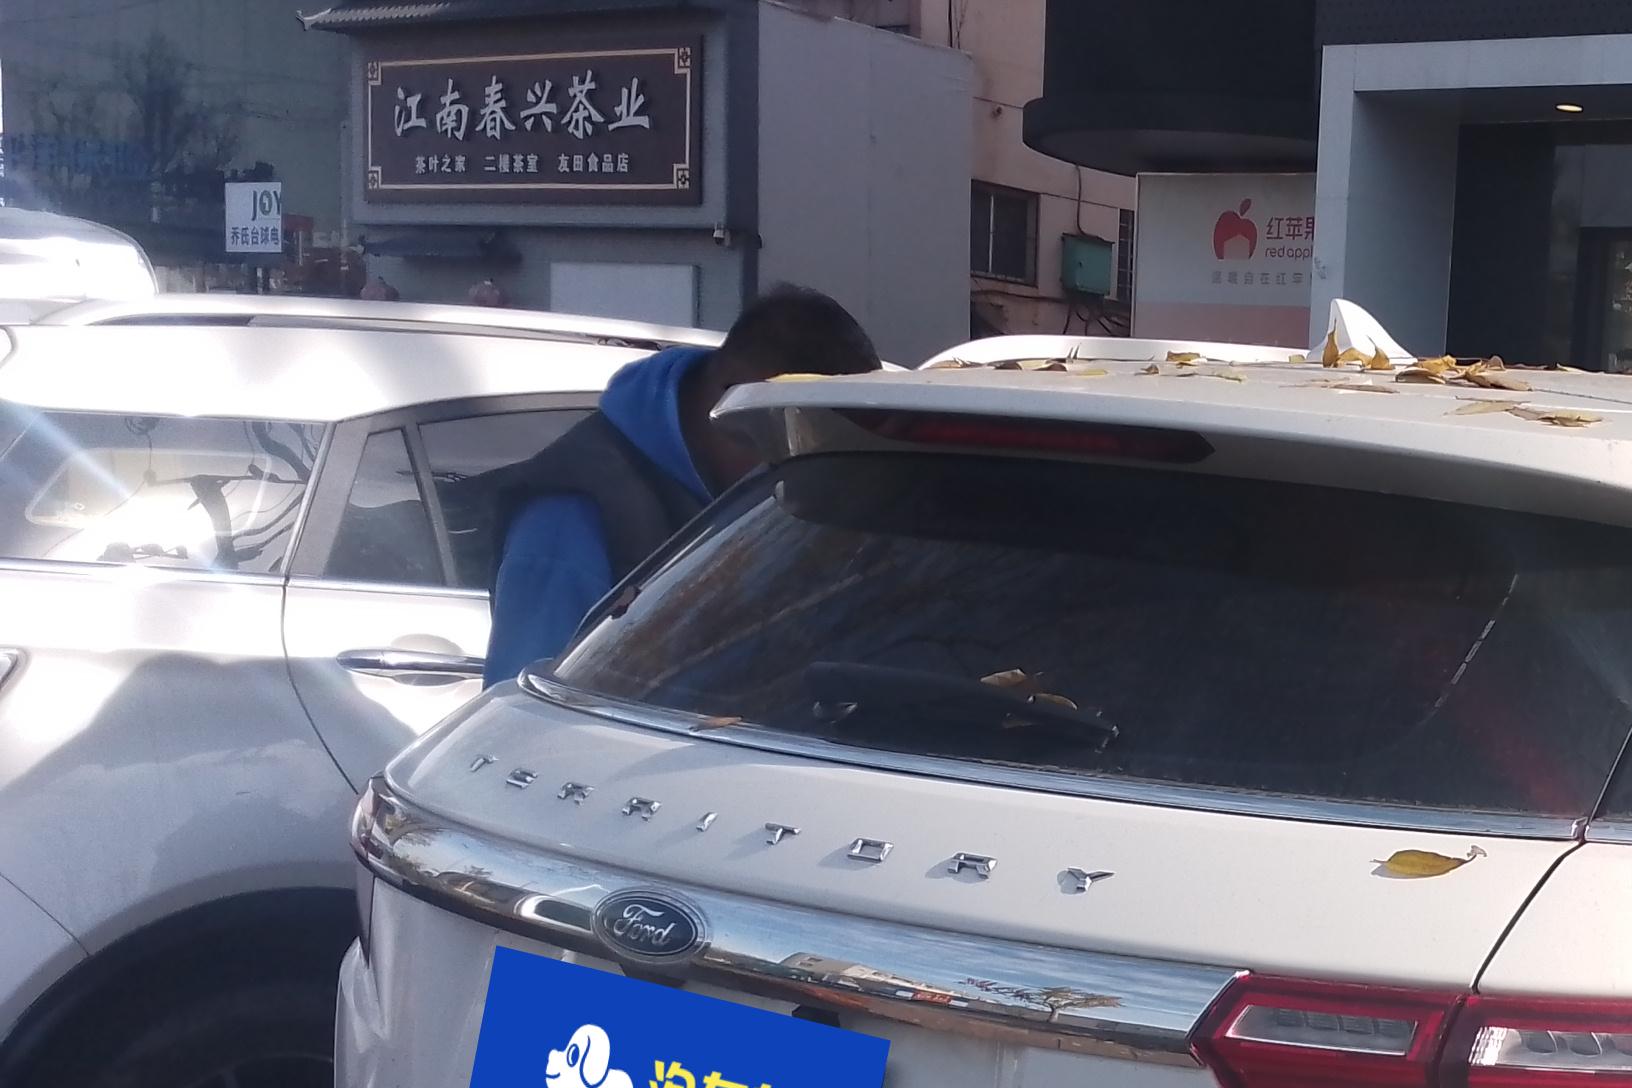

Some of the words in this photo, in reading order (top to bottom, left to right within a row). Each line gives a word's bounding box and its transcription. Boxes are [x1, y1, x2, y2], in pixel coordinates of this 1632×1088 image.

[394, 69, 650, 141] 江南春兴茶业
[415, 155, 466, 174] 茶叶之家
[484, 154, 539, 174] 二楼茶室
[558, 152, 629, 174] 友田食品店
[1266, 216, 1315, 241] 红苹果
[469, 752, 1117, 894] TERRITORY
[613, 903, 677, 946] Ford
